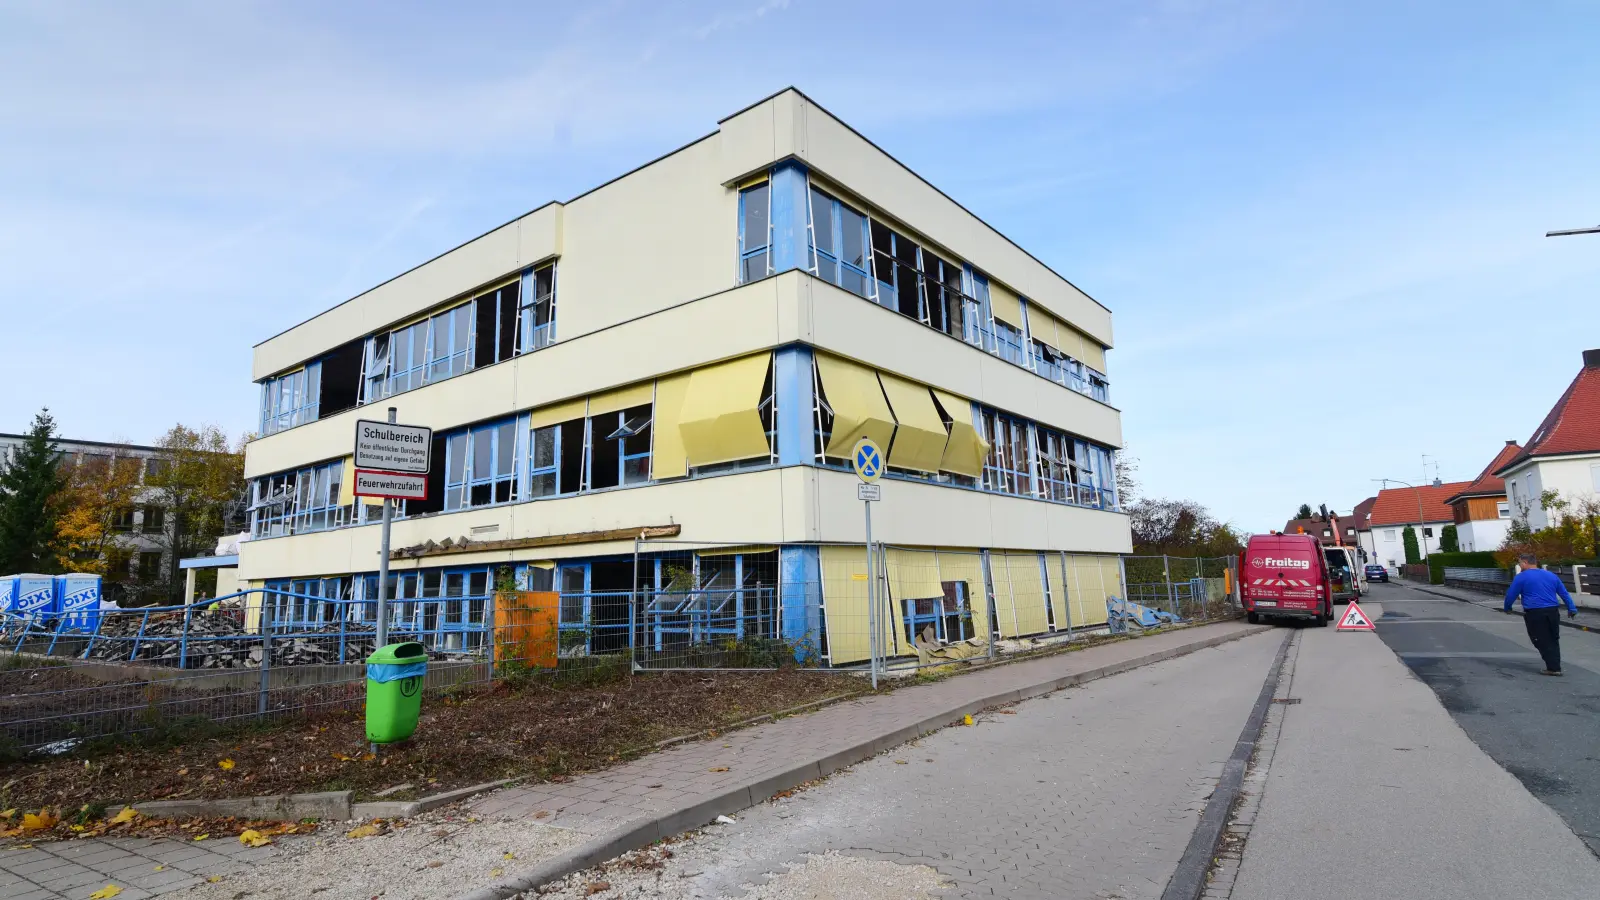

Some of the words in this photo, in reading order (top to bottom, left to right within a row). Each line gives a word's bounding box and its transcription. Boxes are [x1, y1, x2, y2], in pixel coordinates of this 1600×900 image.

[364, 427, 424, 444] Schulbereich
[372, 443, 400, 453] öffentlicher
[400, 447, 426, 457] Durchgang
[359, 452, 384, 462] Benutzung
[393, 456, 409, 464] eigene
[358, 477, 423, 491] Feuerwehrzufahrt
